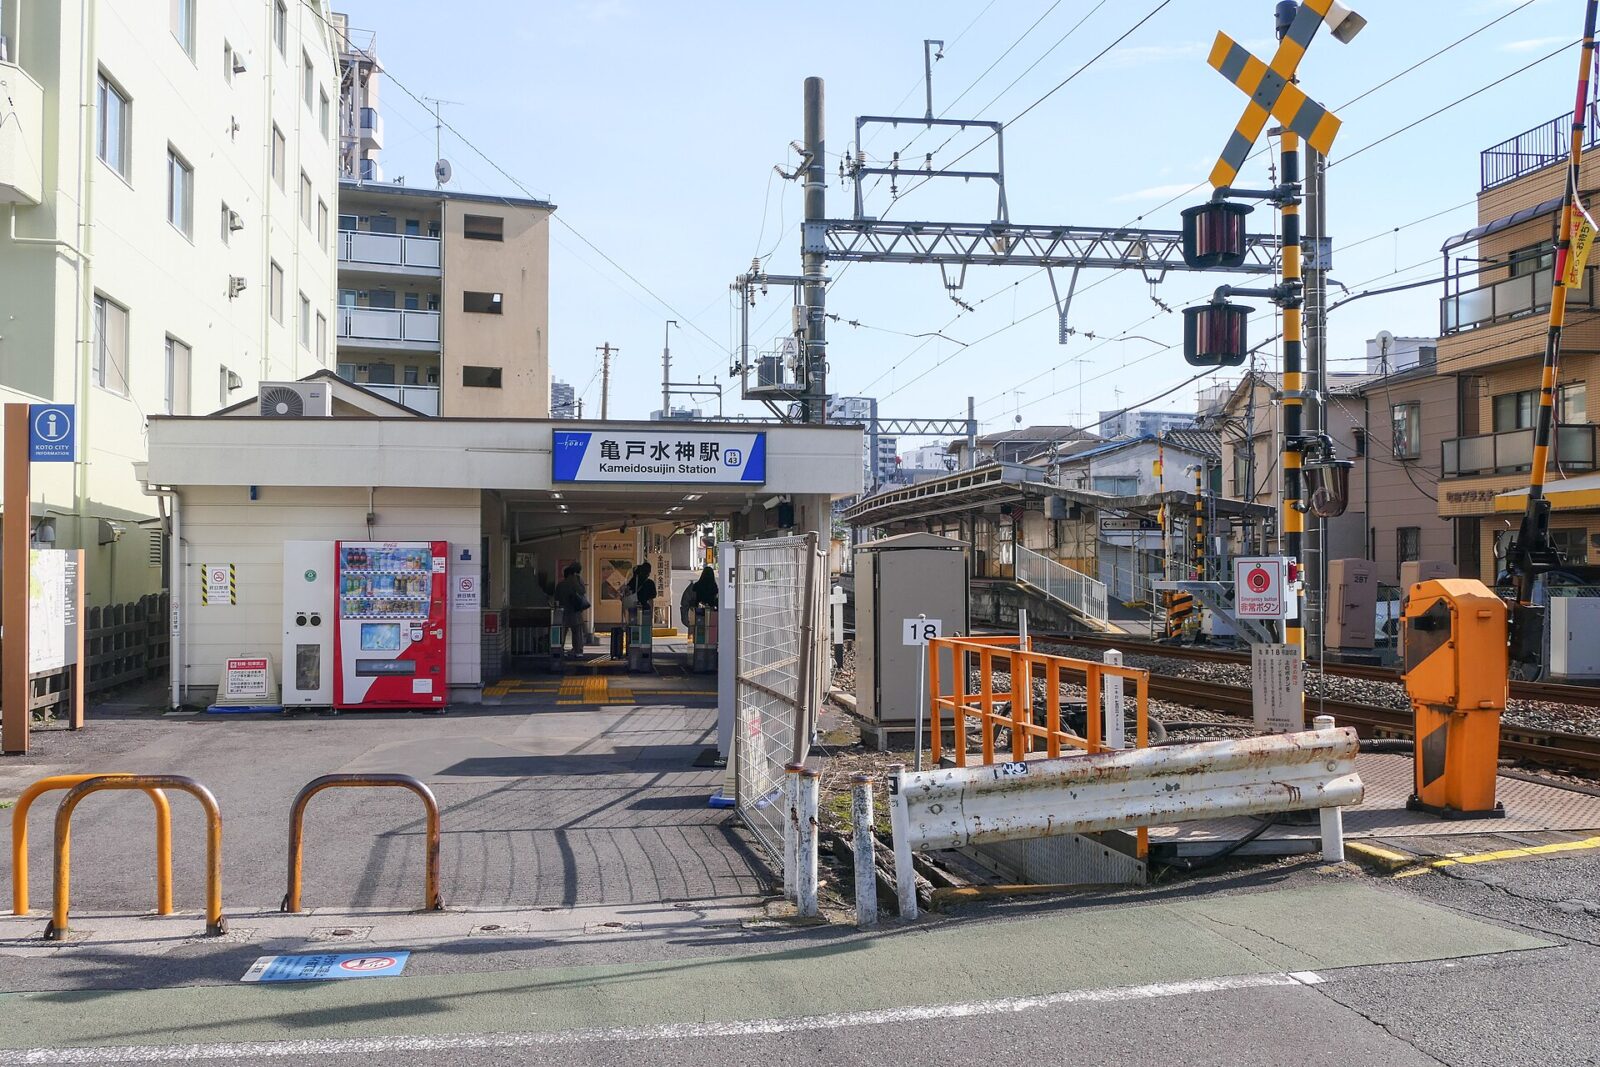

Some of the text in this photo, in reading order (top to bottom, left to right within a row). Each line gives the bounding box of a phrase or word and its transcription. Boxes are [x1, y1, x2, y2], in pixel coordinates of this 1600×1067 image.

[599, 439, 720, 462] 亀戸水神駅
[599, 463, 716, 475] Kameidosuijin Station
[1241, 602, 1279, 612] 非常ボタン
[910, 623, 937, 640] 18
